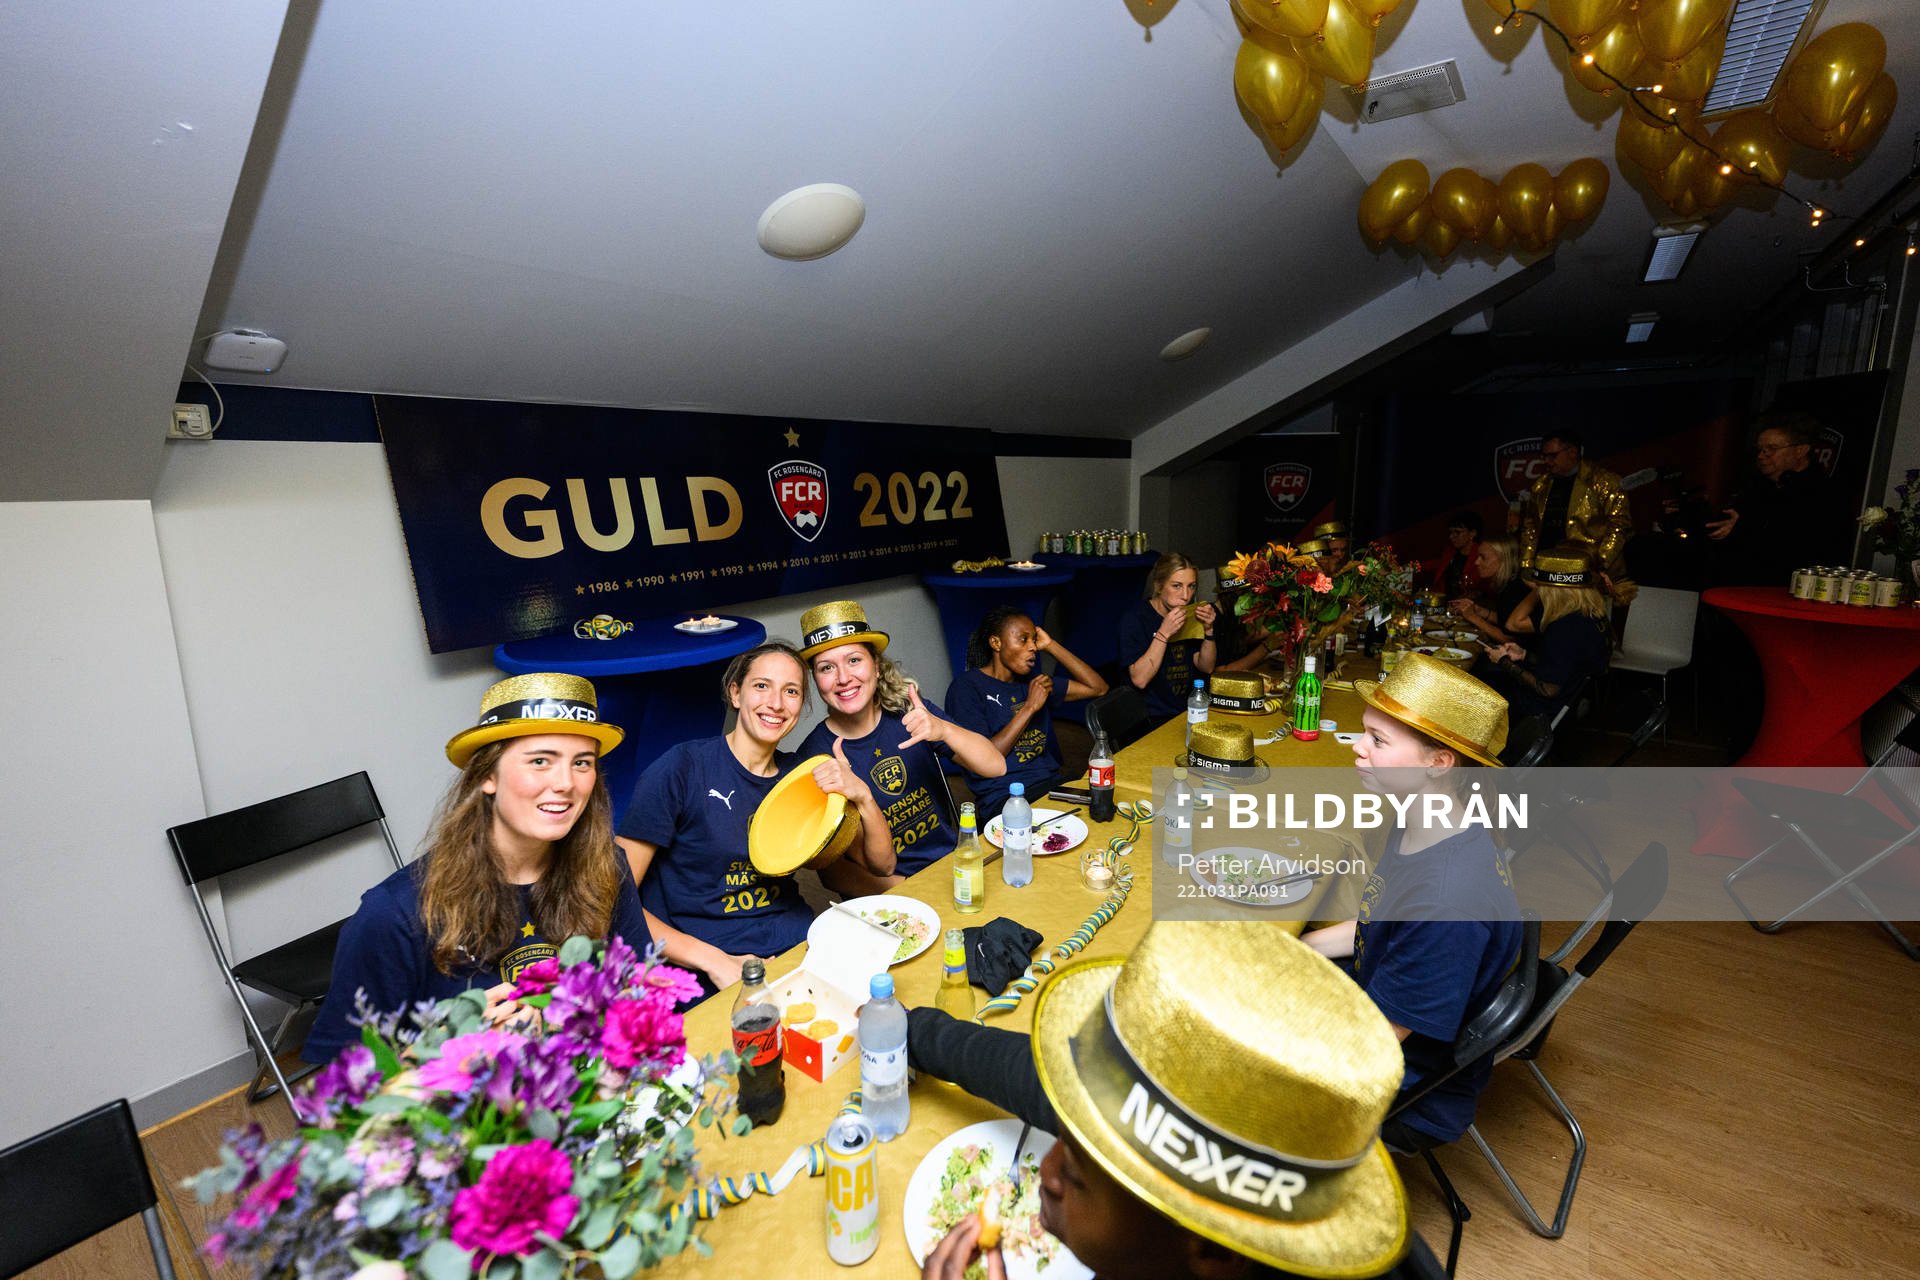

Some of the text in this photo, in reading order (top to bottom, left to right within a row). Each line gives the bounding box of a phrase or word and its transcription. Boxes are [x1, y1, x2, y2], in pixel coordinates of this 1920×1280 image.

[773, 465, 822, 479] FC ROSENGÅRD
[1270, 475, 1305, 488] FCR
[781, 481, 822, 502] FCR
[480, 470, 973, 559] GULD 2022
[588, 580, 619, 594] 1986
[636, 575, 665, 588] 1990
[680, 570, 706, 582] 1991
[720, 565, 744, 577] 1993
[756, 560, 778, 572] 1994
[790, 557, 810, 568] 2010
[820, 553, 839, 564] 2011
[875, 547, 892, 556] 2014
[878, 765, 901, 784] FCR
[882, 786, 928, 817] VENSKA
[892, 813, 940, 854] 2022
[728, 860, 753, 872] SVE
[725, 871, 758, 886] MÄS
